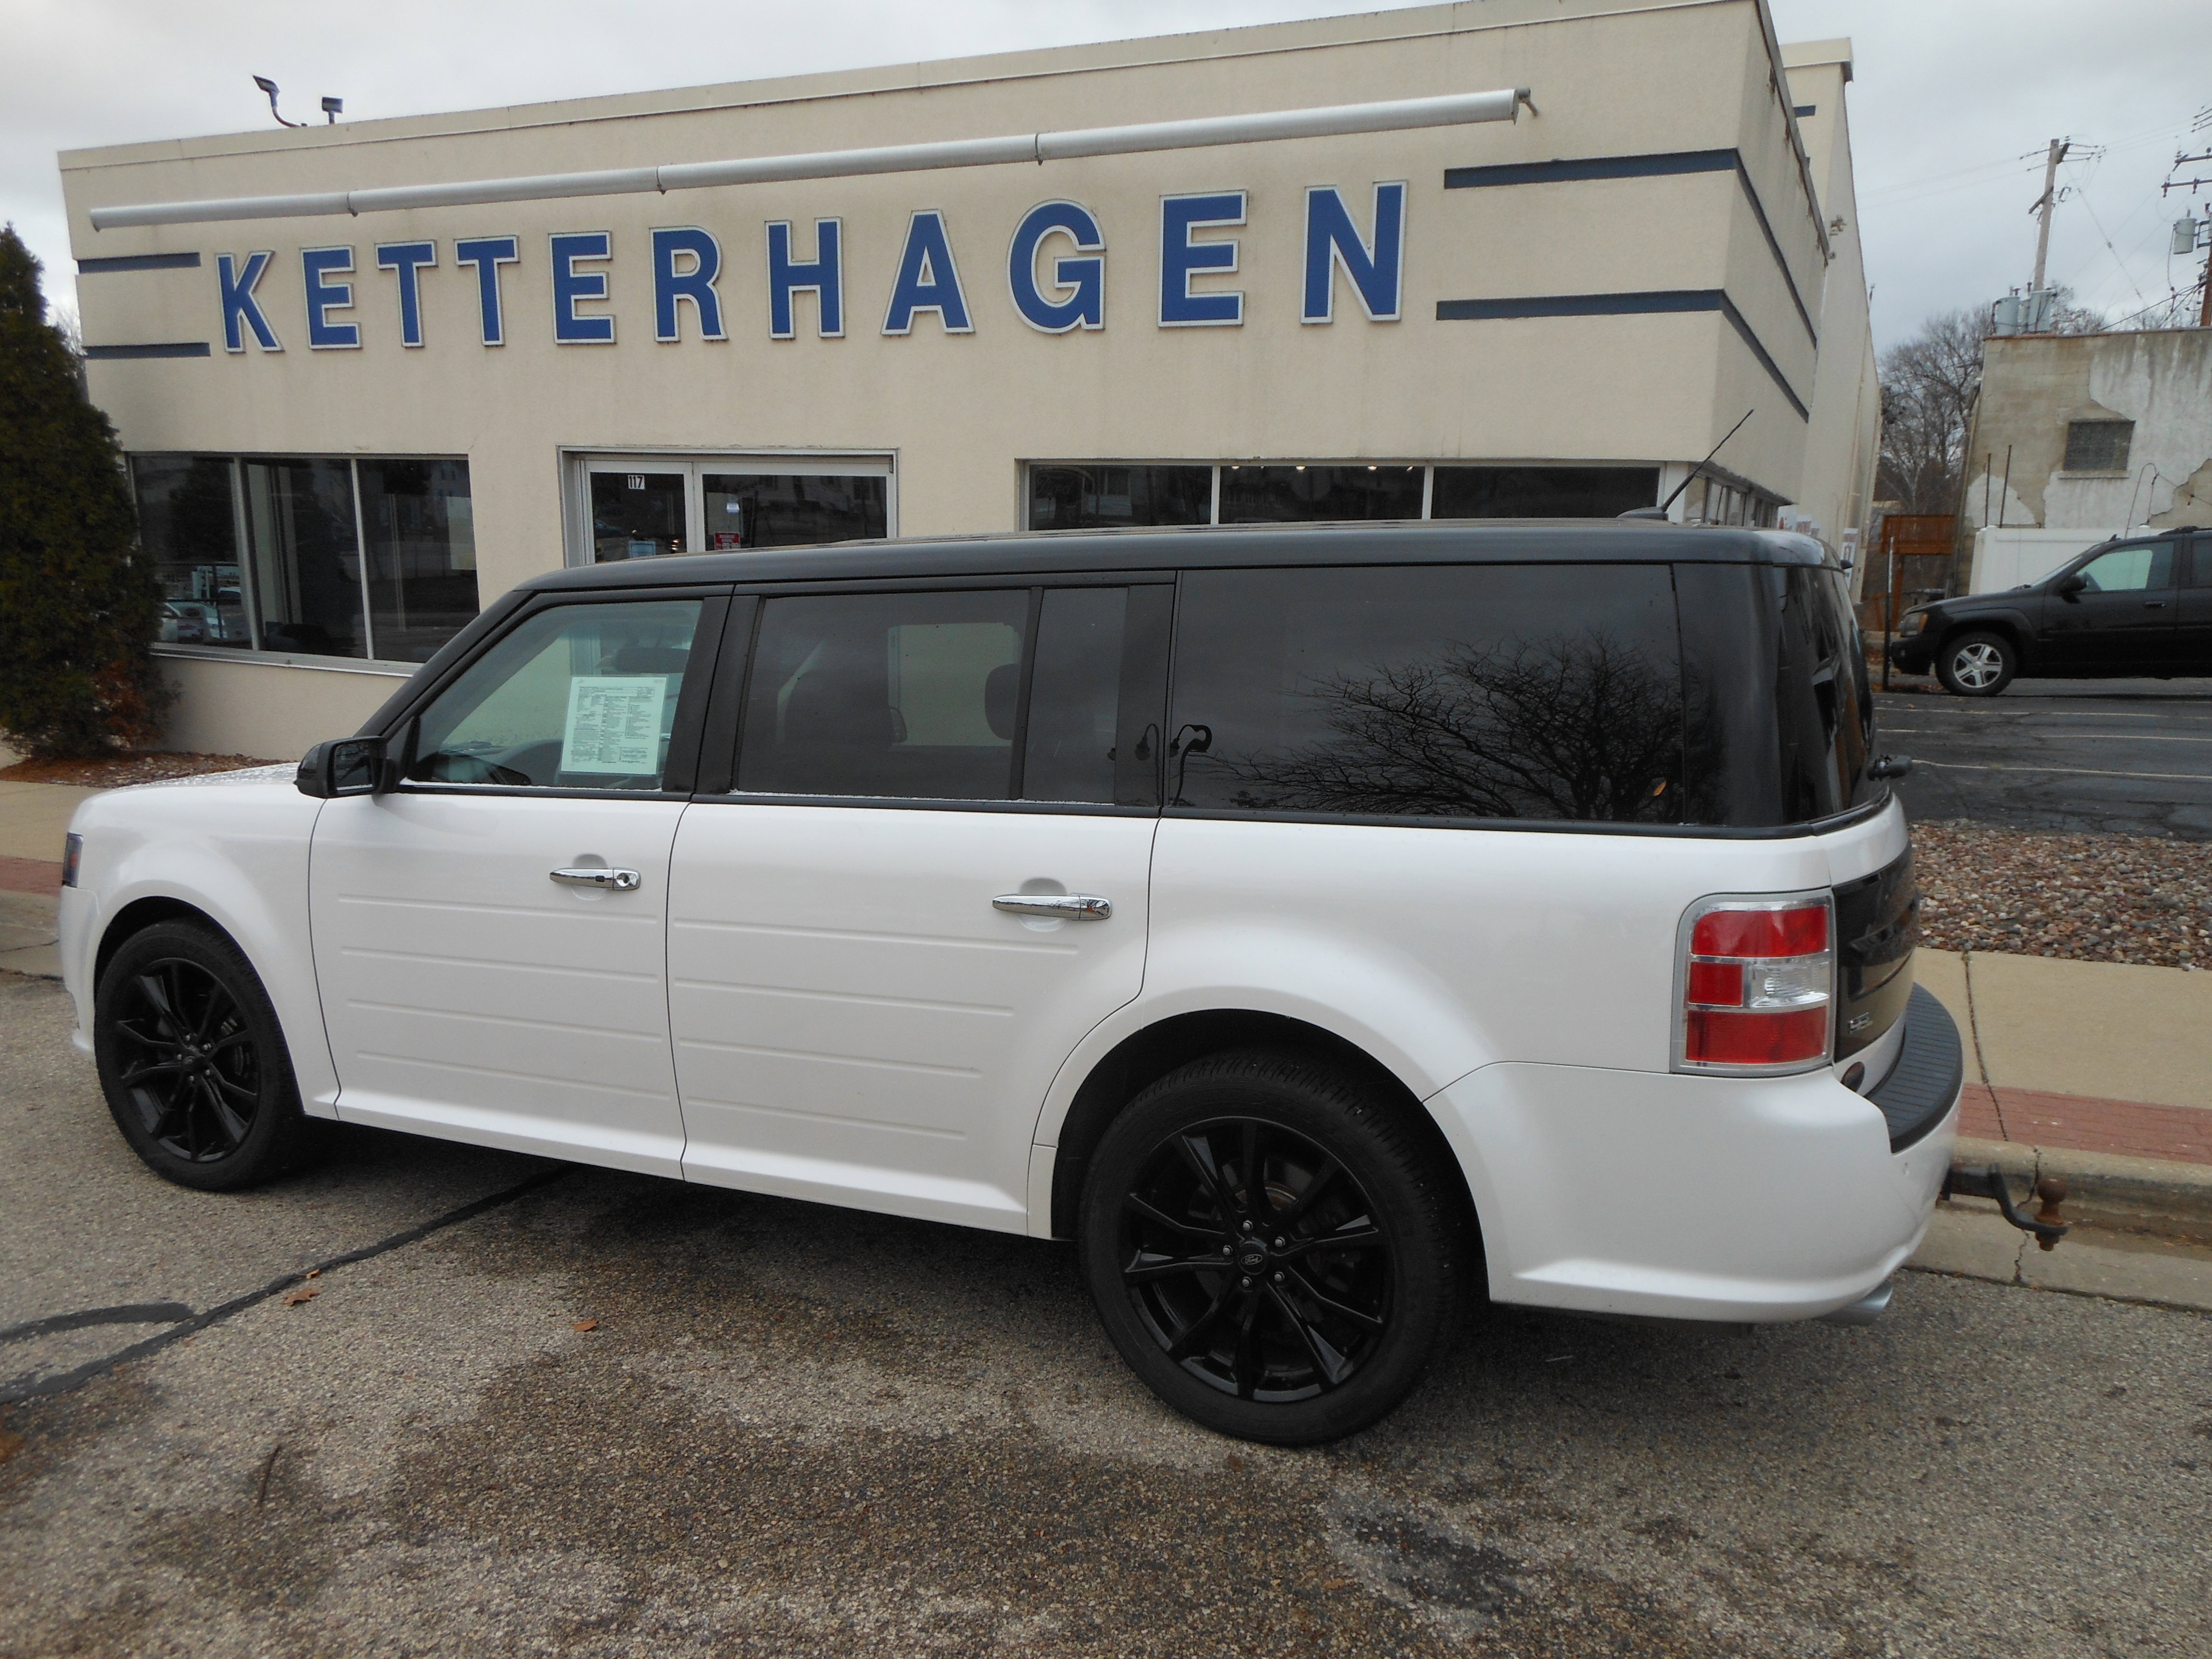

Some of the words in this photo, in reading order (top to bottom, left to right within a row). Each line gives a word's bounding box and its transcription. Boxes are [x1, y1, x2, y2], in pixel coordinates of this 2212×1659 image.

[215, 179, 1408, 353] KETTERHAGEN
[629, 475, 643, 488] 117
[1244, 1255, 1259, 1264] Ford
